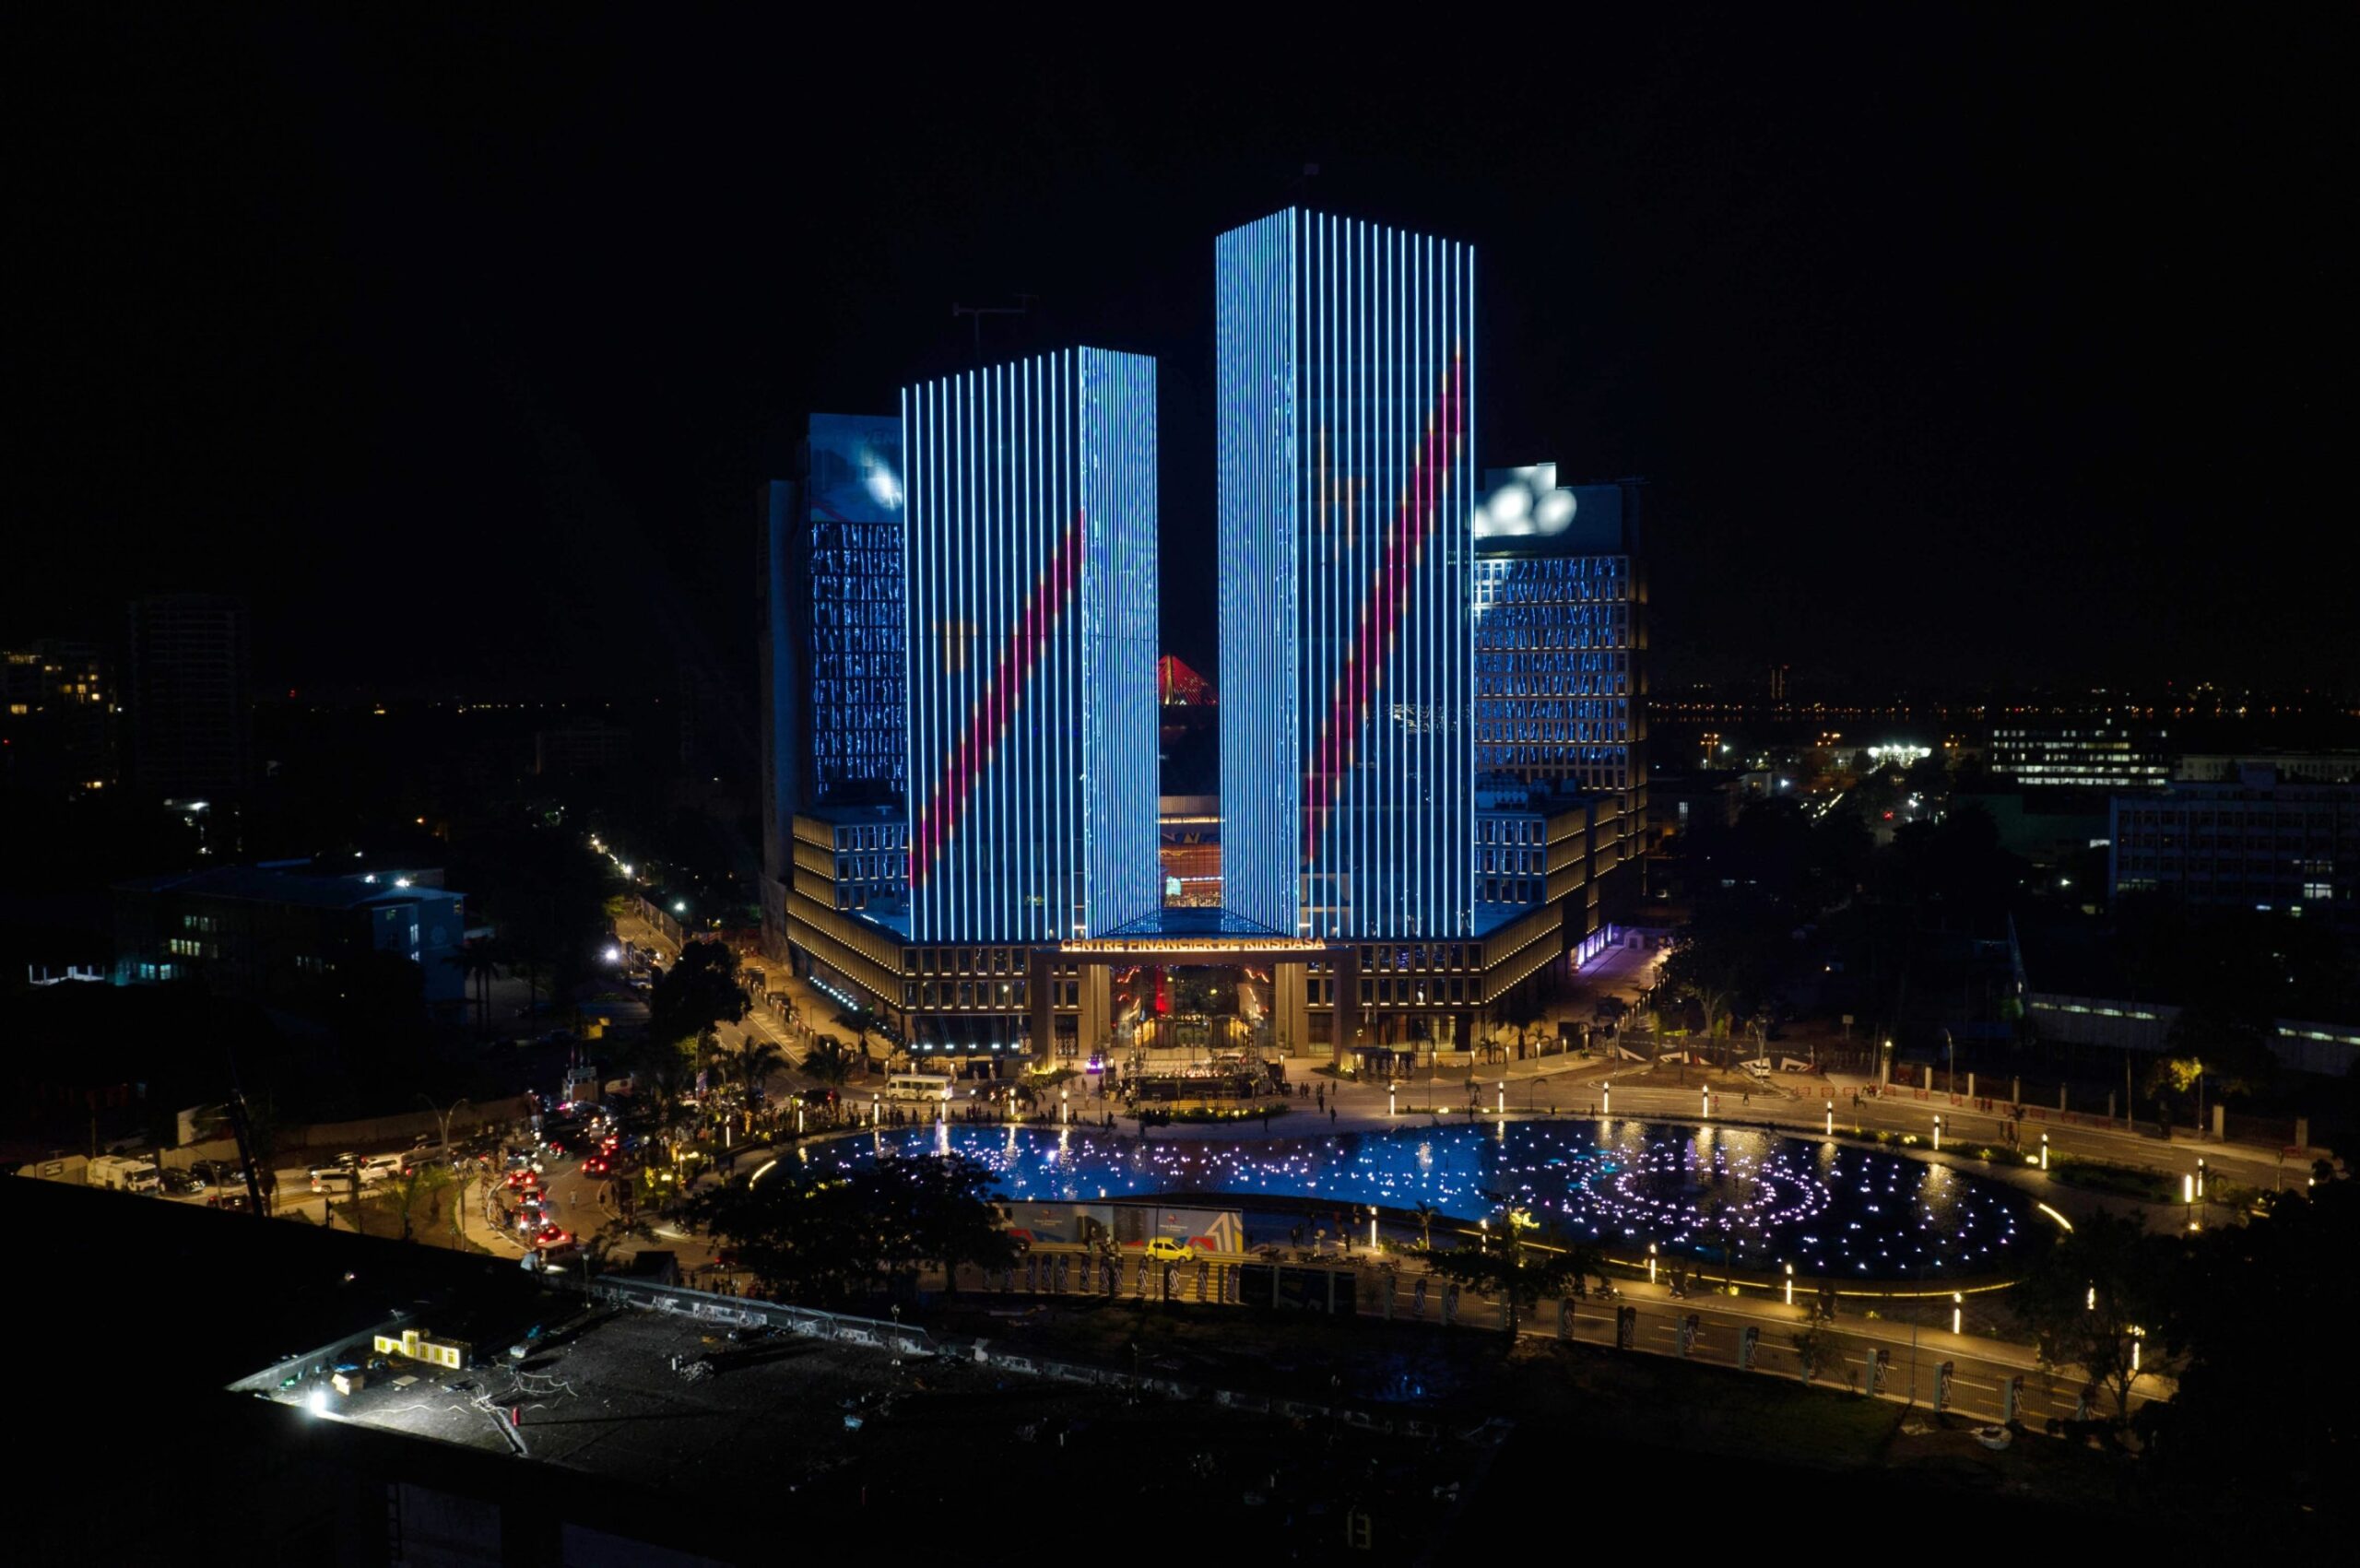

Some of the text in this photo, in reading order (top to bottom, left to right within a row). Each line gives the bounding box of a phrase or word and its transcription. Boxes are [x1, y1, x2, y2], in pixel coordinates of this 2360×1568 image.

[1060, 937, 1327, 951] CENTRE FINANCIER DE KINSHASA
